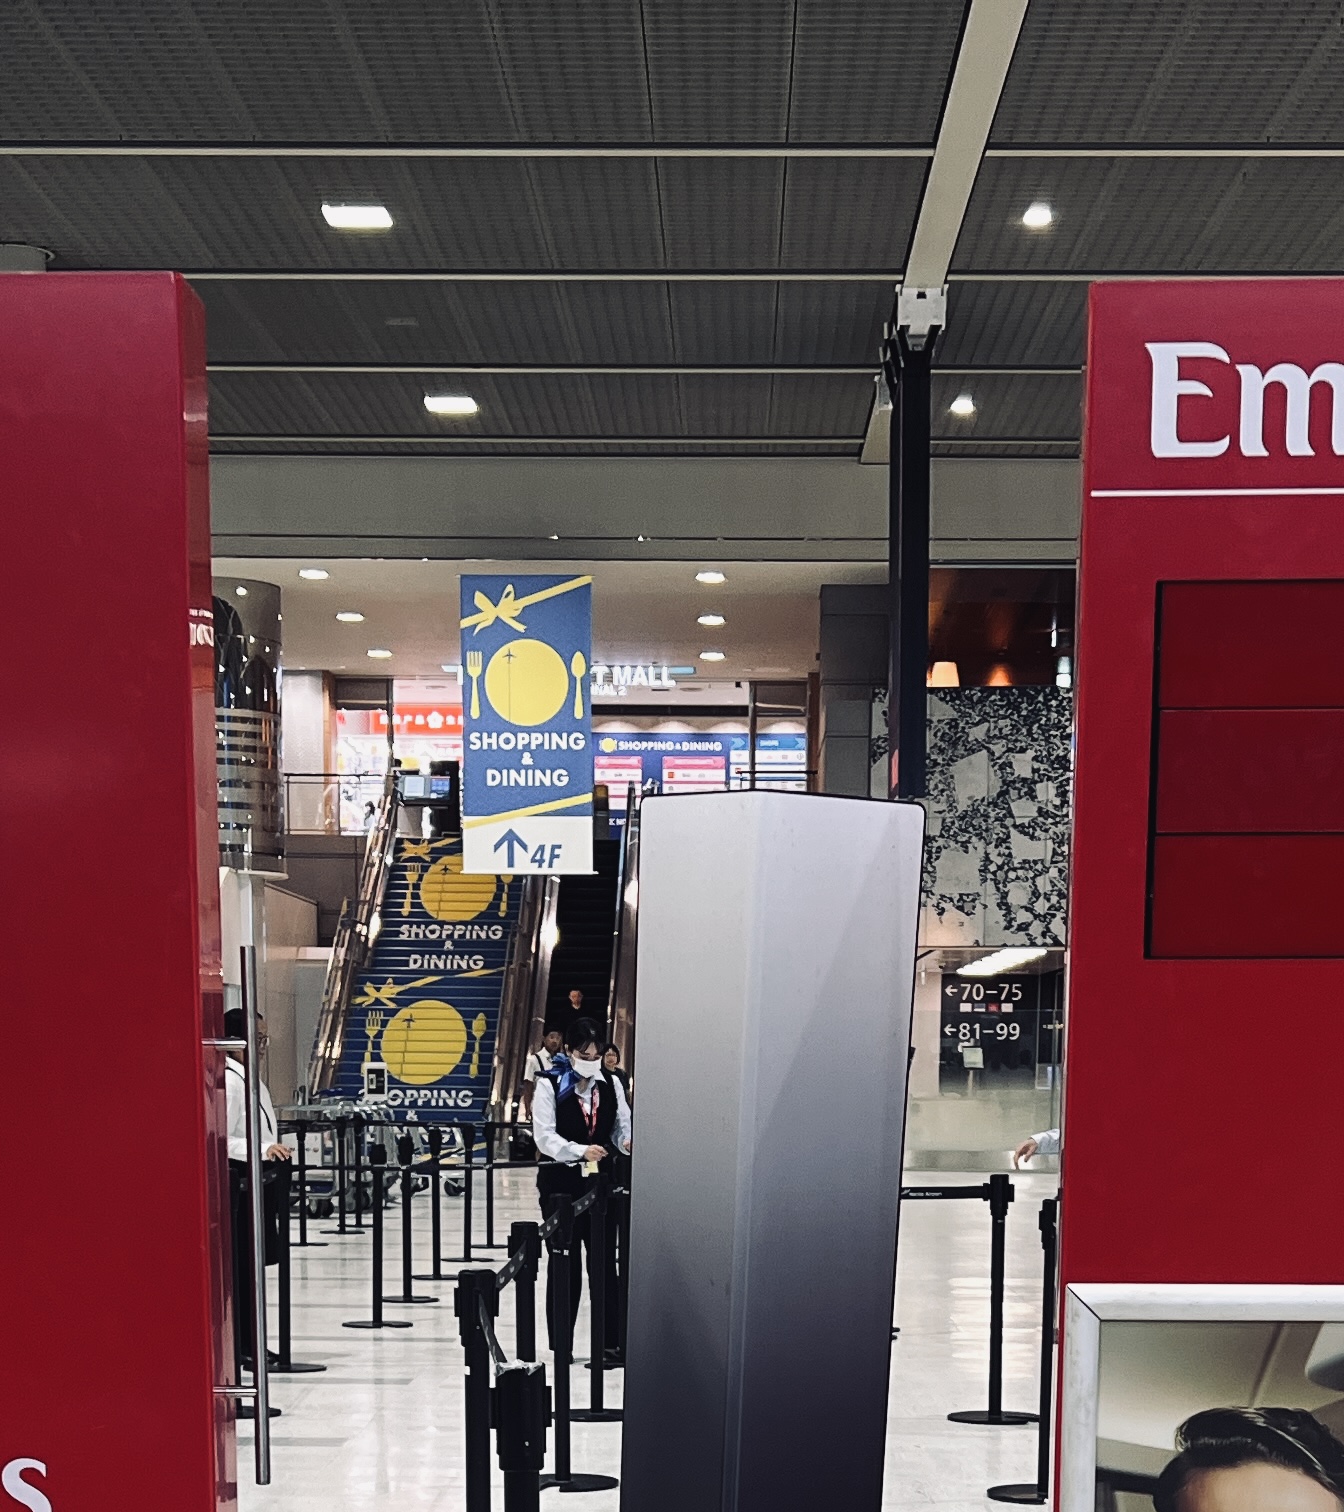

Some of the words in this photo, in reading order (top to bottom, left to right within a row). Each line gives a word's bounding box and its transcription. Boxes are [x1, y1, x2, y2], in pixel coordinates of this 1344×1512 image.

[612, 665, 676, 687] MALL
[469, 732, 586, 750] SHOPPING
[521, 752, 534, 765] &
[486, 769, 570, 787] DINING
[530, 844, 562, 869] 4F
[399, 924, 503, 940] SHOPPING
[408, 954, 484, 970] DINING
